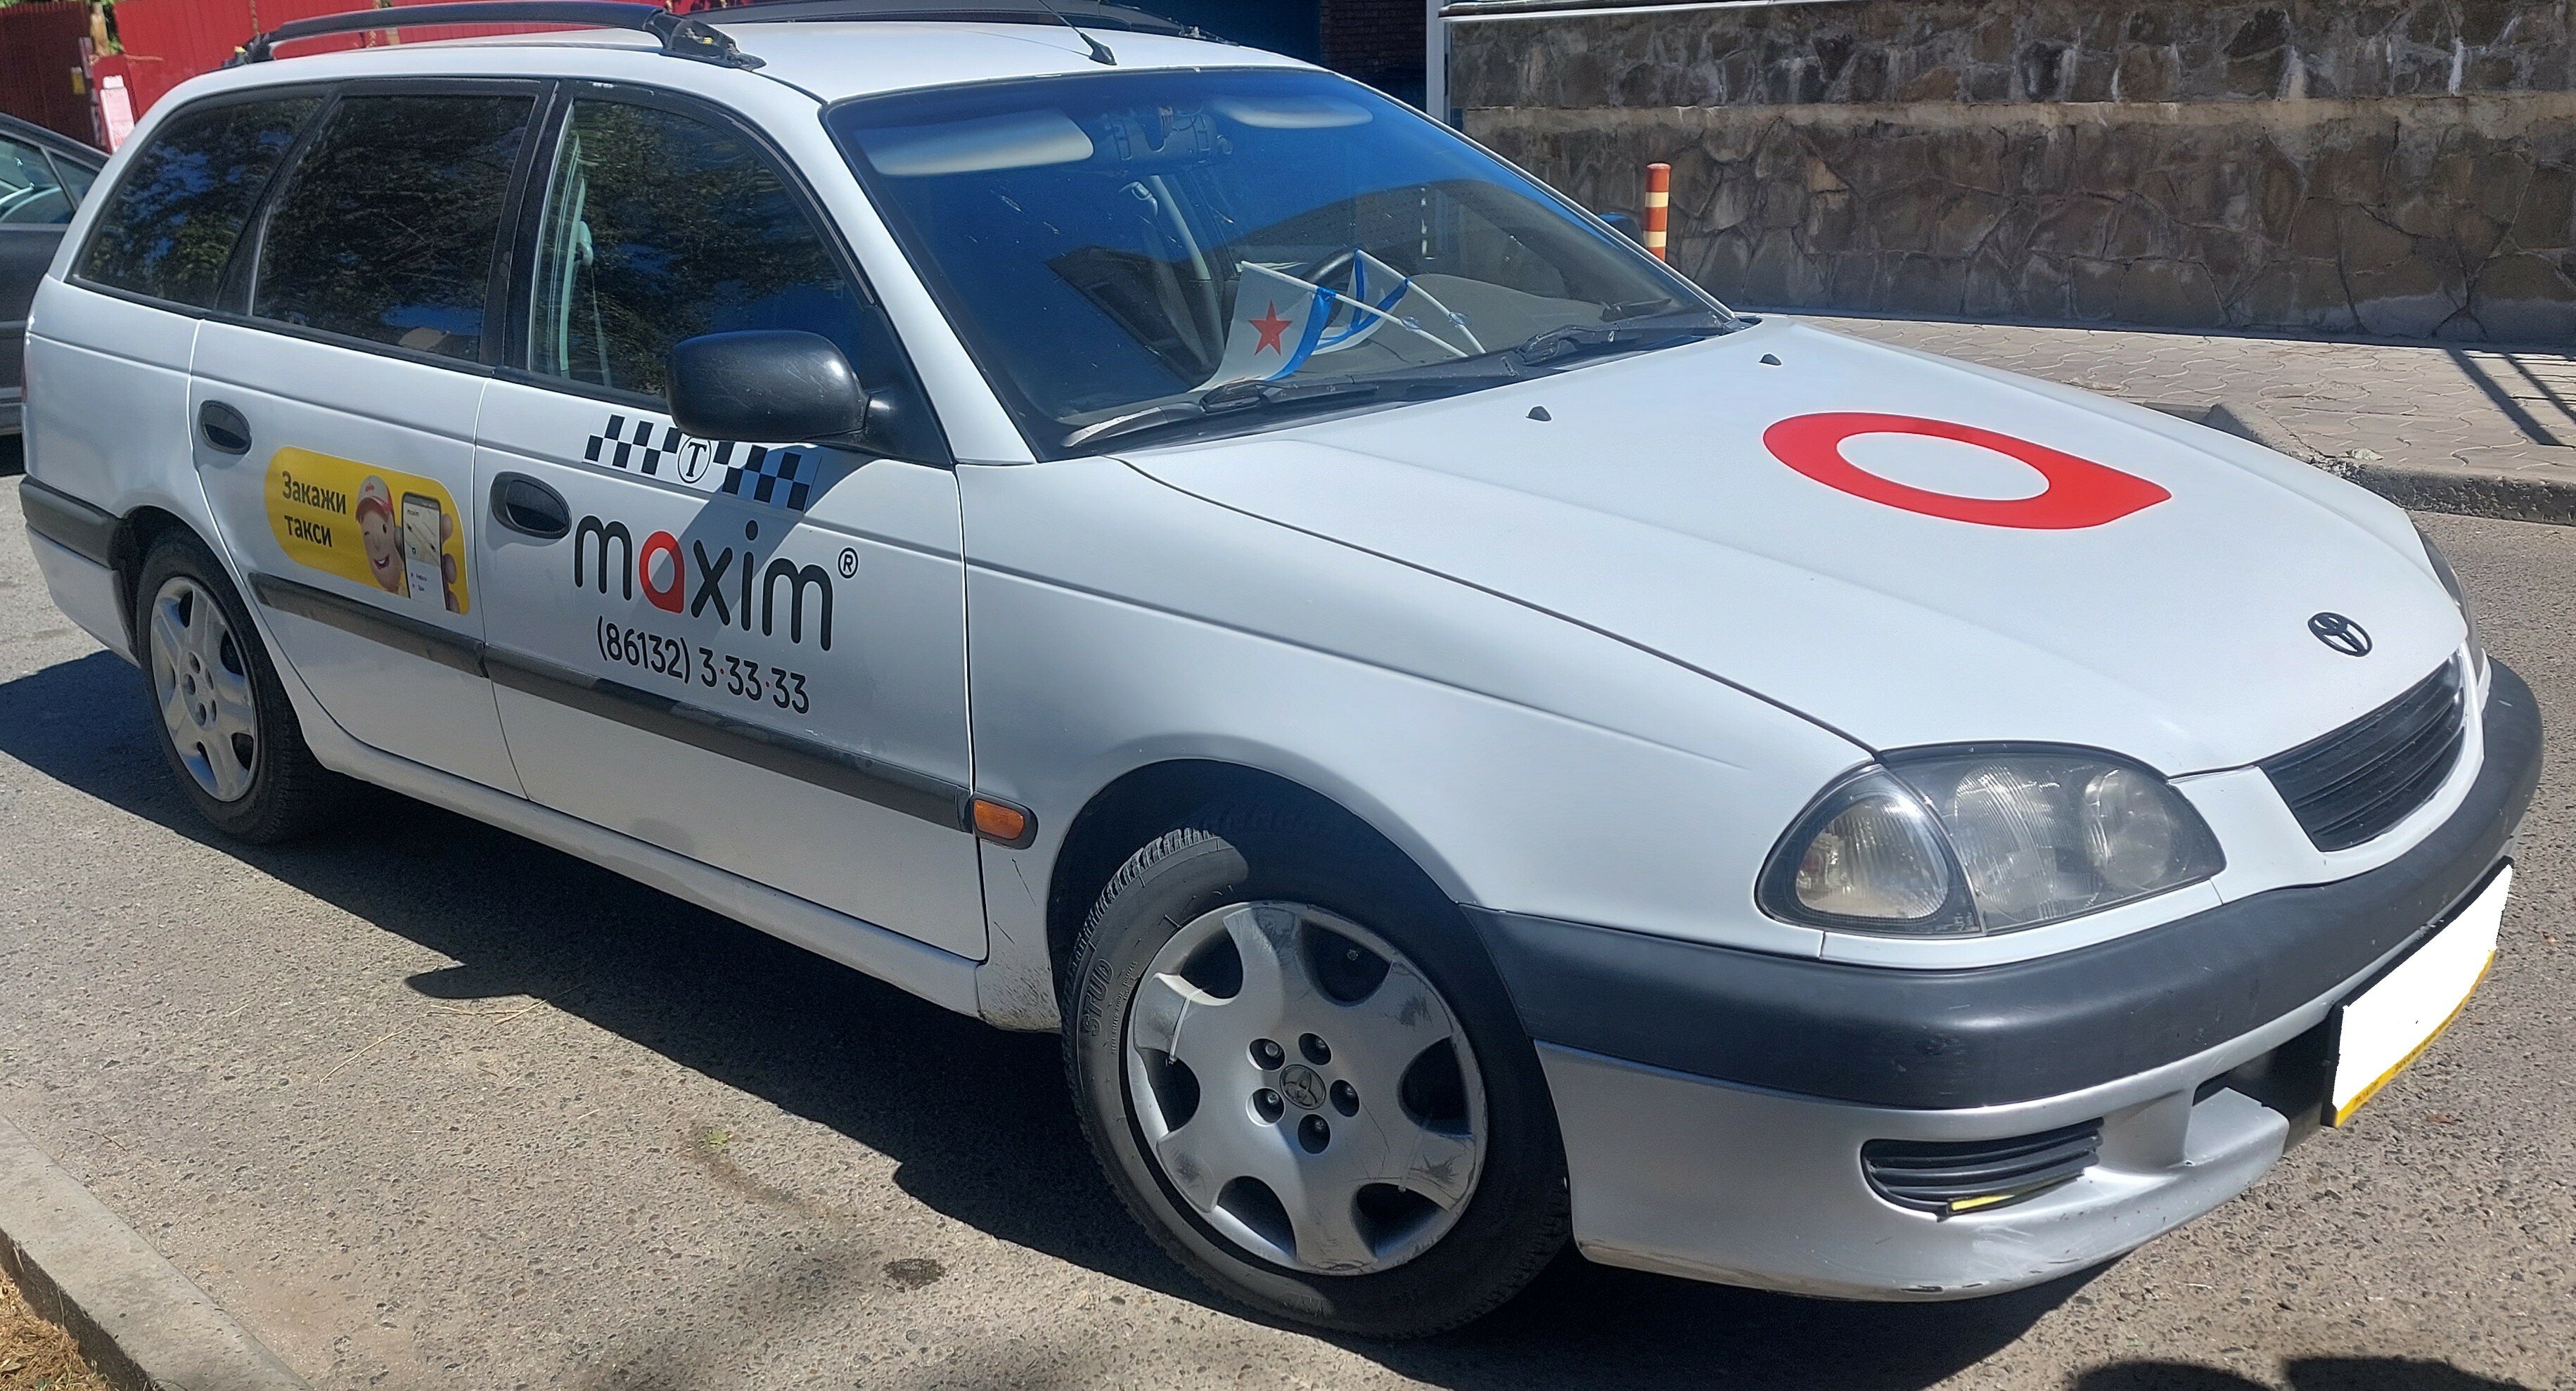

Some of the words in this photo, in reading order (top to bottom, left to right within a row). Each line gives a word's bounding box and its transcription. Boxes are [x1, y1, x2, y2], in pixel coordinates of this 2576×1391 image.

[282, 470, 347, 515] Закажи
[283, 514, 333, 548] такси
[574, 515, 833, 651] maxim
[596, 615, 691, 684] (86132)
[1082, 958, 1114, 1037] STUD
